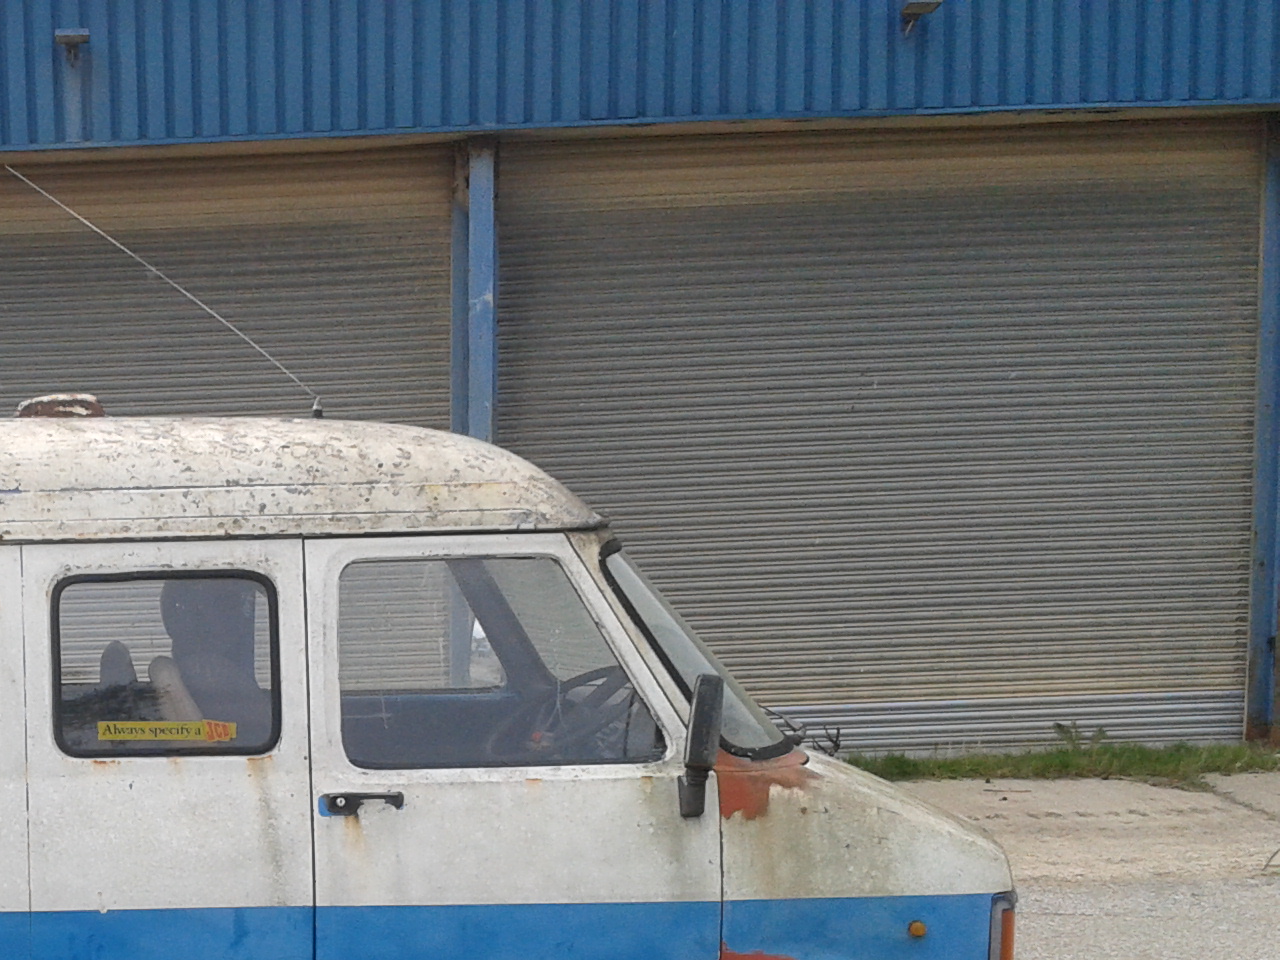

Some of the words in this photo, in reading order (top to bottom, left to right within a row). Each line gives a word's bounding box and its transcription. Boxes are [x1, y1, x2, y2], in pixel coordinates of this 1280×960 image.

[102, 723, 146, 737] Always
[148, 723, 191, 738] specify
[194, 727, 201, 736] a
[206, 722, 230, 741] JCB
